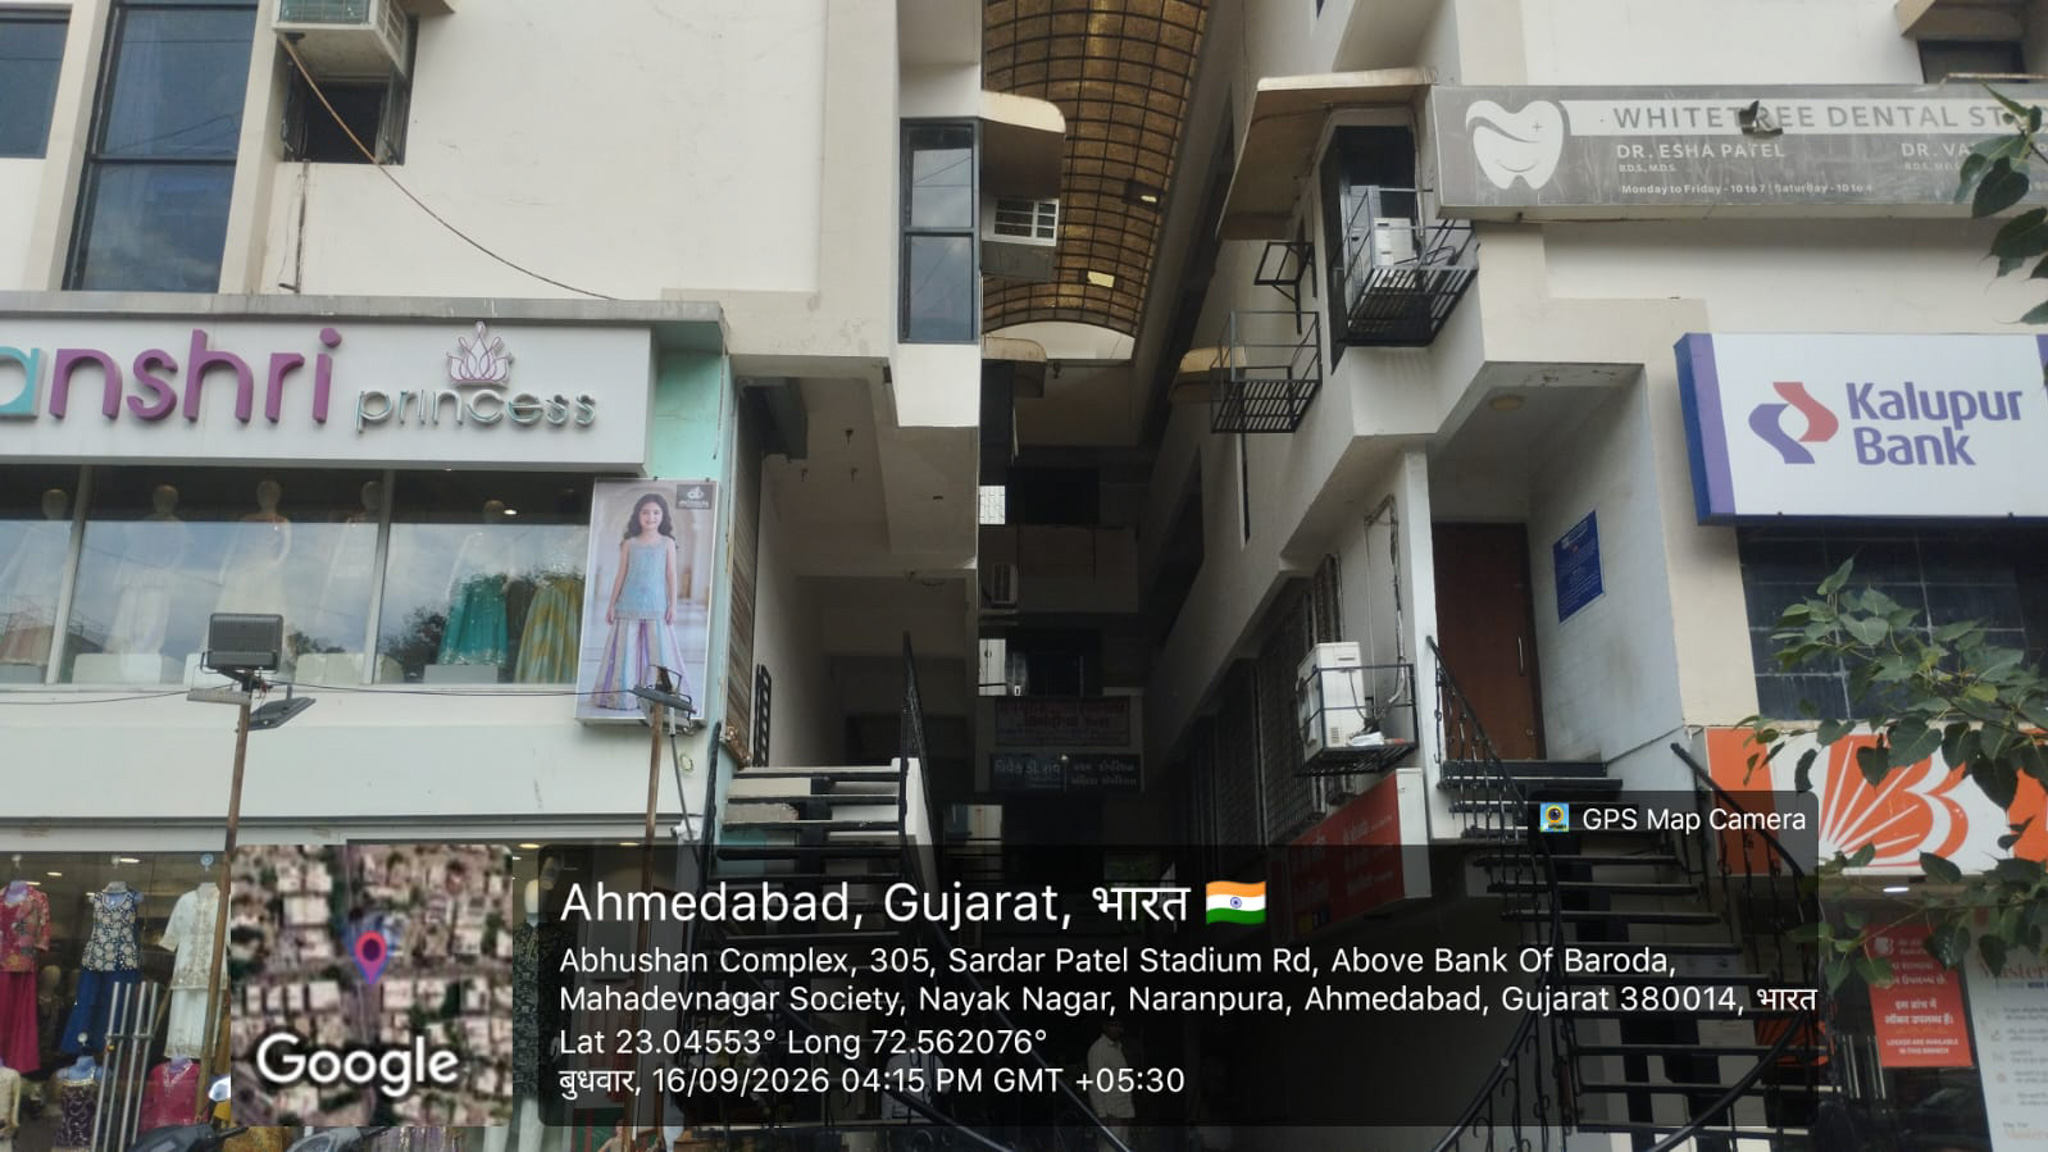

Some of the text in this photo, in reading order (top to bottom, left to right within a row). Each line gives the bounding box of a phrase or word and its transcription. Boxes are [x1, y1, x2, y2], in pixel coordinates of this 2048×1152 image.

[1827, 105, 1959, 128] DENTAL
[1616, 143, 1786, 159] DR. ESHA PATEL
[1901, 142, 1937, 158] DR.
[1621, 184, 1668, 196] Monday
[1670, 184, 1683, 194] to
[1684, 184, 1722, 196] Friday
[1730, 184, 1744, 194] 10
[355, 388, 597, 433] princess
[1846, 382, 2024, 430] Kalupur
[1853, 426, 1976, 466] Bank
